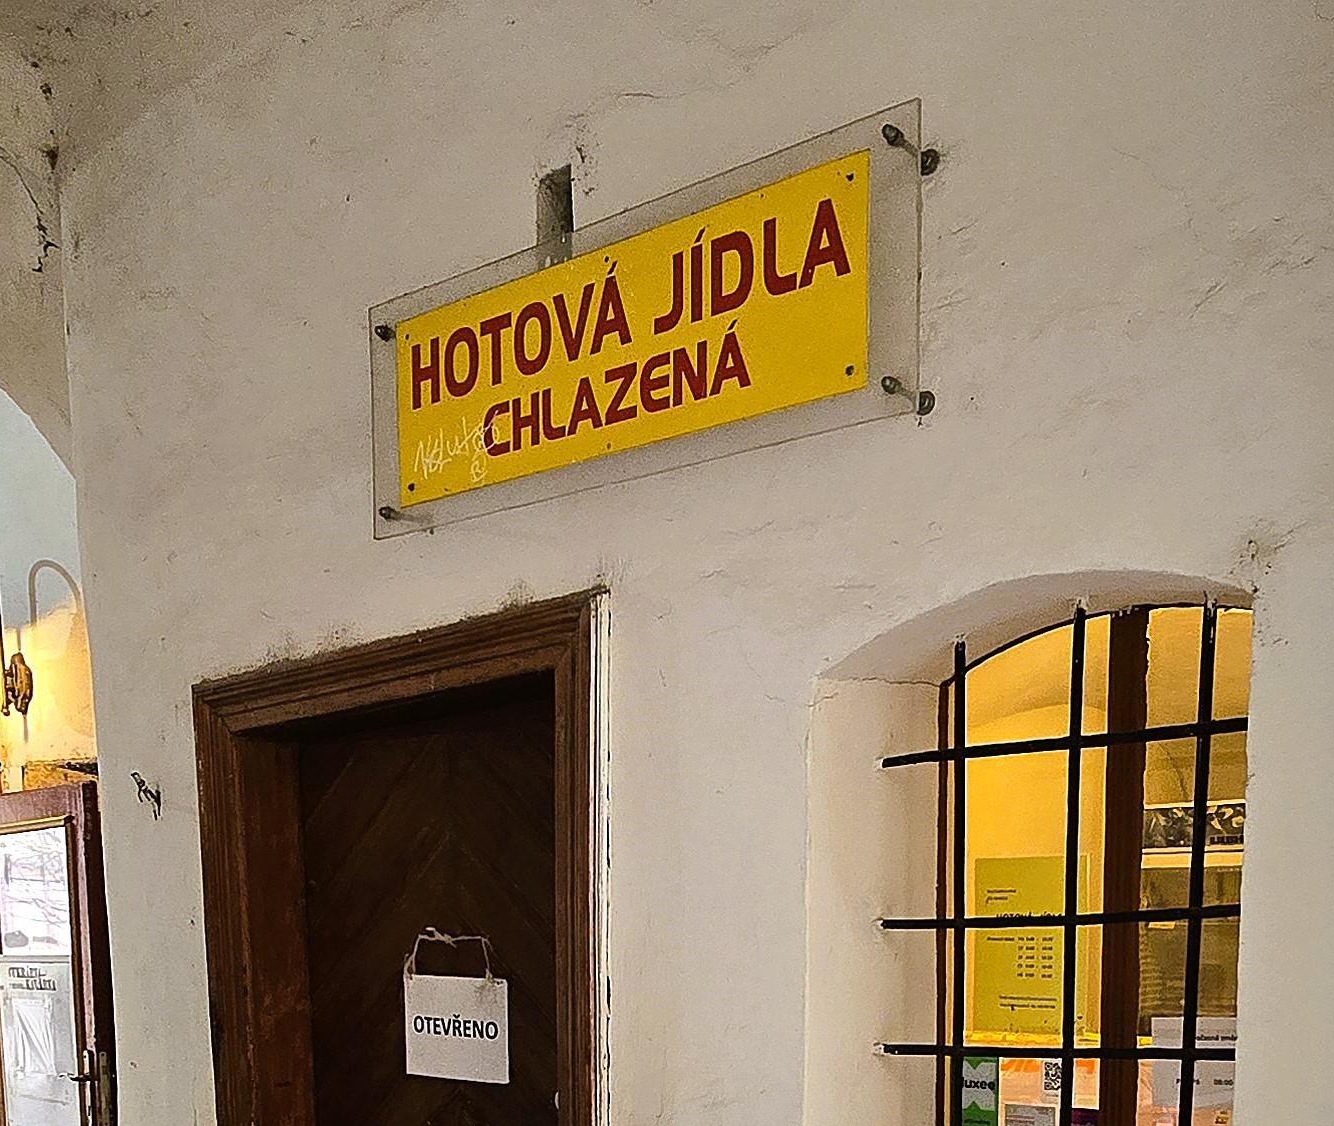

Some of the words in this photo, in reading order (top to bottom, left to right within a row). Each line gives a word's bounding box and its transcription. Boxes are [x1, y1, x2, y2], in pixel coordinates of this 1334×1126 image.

[411, 261, 633, 411] HOTOVÁ
[653, 198, 852, 336] JÍDLA
[483, 319, 752, 457] CHLAZENÁ
[413, 1014, 499, 1040] OTEVŘENO
